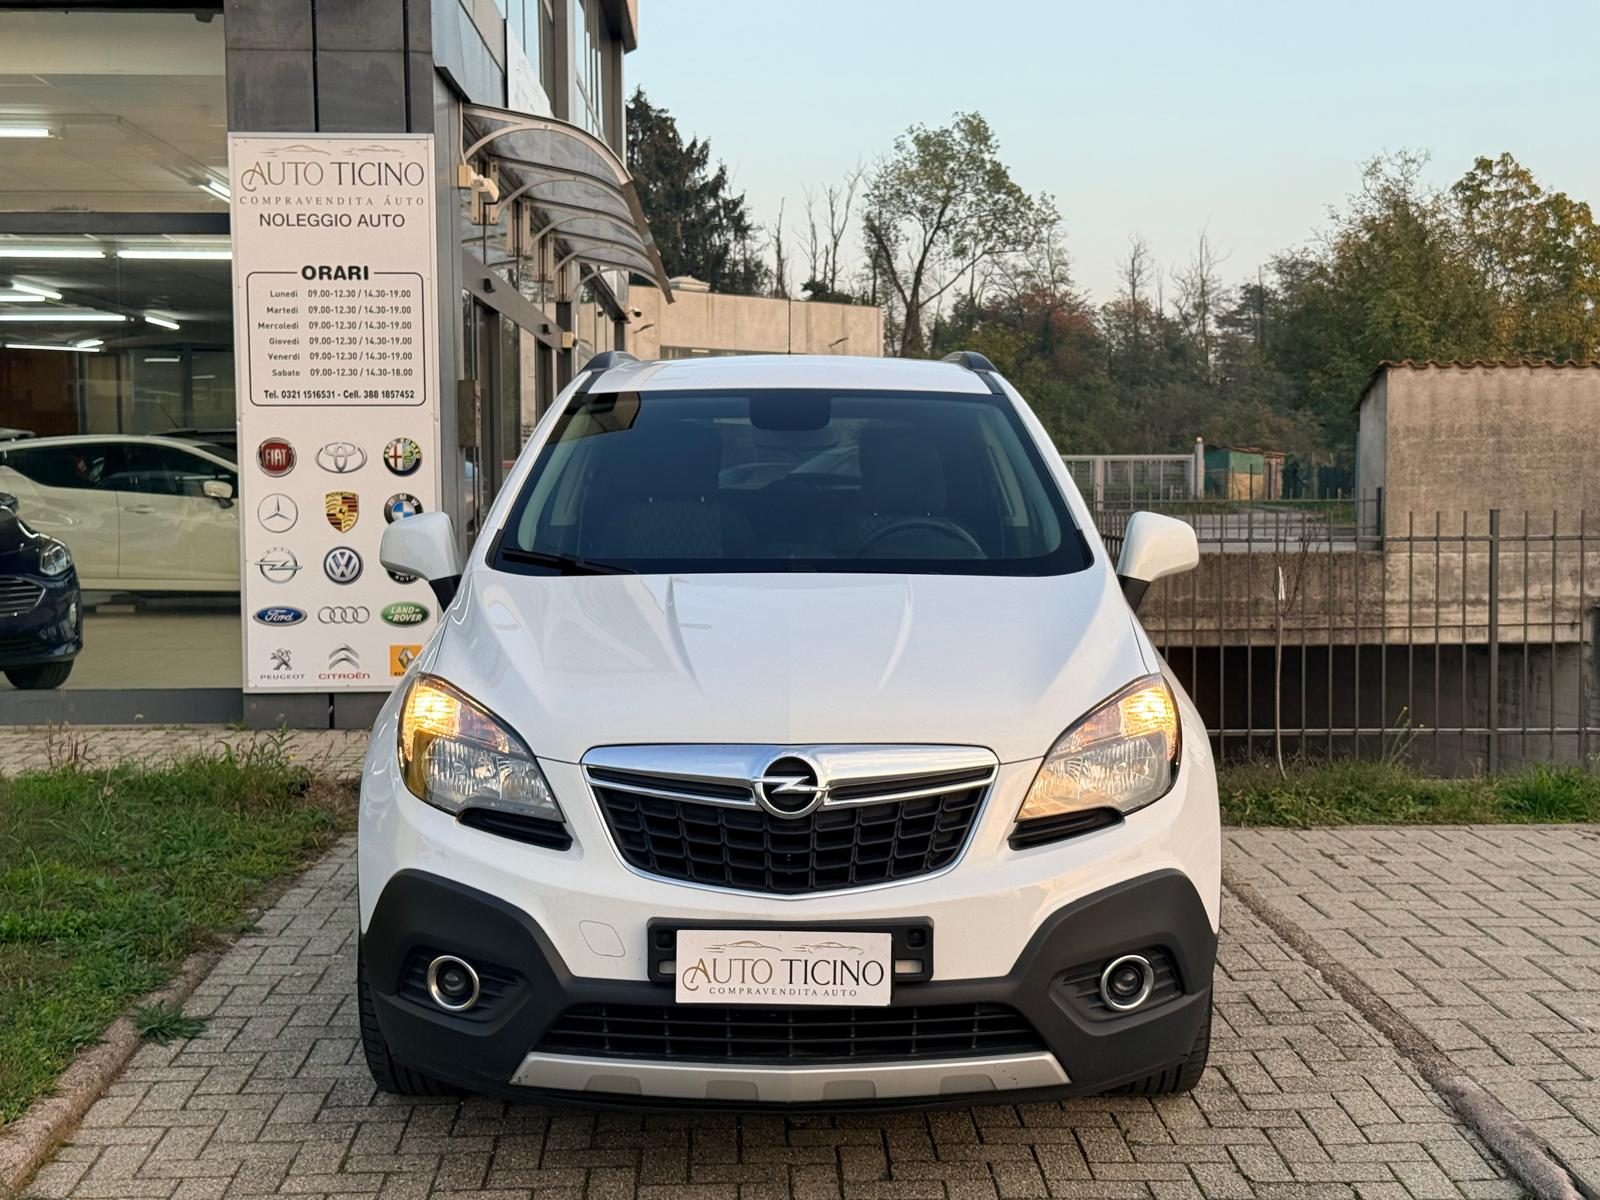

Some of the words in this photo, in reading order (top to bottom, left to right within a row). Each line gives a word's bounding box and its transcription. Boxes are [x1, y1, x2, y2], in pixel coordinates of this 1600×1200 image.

[240, 161, 324, 193] AUTO
[329, 161, 425, 187] TICINO
[239, 196, 374, 206] COMPRAVENDITA
[259, 213, 352, 228] NOLEGGIO
[357, 213, 406, 228] AUTO
[301, 265, 369, 281] ORARI
[307, 289, 356, 298] 09.00-12.30
[363, 289, 411, 298] 14.30-19.00
[308, 305, 357, 315] 09.00-12.30
[364, 305, 412, 315] 14.30-19.00
[308, 320, 357, 330] 09.00-12.30
[364, 320, 412, 330] 14.30-19.00
[309, 336, 358, 346] 09.00-12.30
[365, 336, 413, 346] 14.30-19.00
[309, 351, 358, 361] 09.00-12.30
[365, 351, 413, 361] 14.30-19.00
[271, 368, 301, 377] Sabato
[309, 367, 358, 377] 09.00-12.30
[365, 368, 413, 377] 14.30-18.00
[263, 389, 279, 399] Tel.
[281, 389, 301, 399] 0321
[303, 390, 336, 399] 1516531
[342, 389, 362, 399] Cell.
[363, 389, 379, 399] 388
[381, 389, 415, 399] 1857452
[264, 448, 288, 466] FIAT
[264, 608, 295, 622] Ford
[681, 957, 773, 991] AUTO
[781, 958, 885, 987] TICINO
[709, 987, 818, 997] COMPRAVENDITA
[823, 988, 857, 997] AUTO
